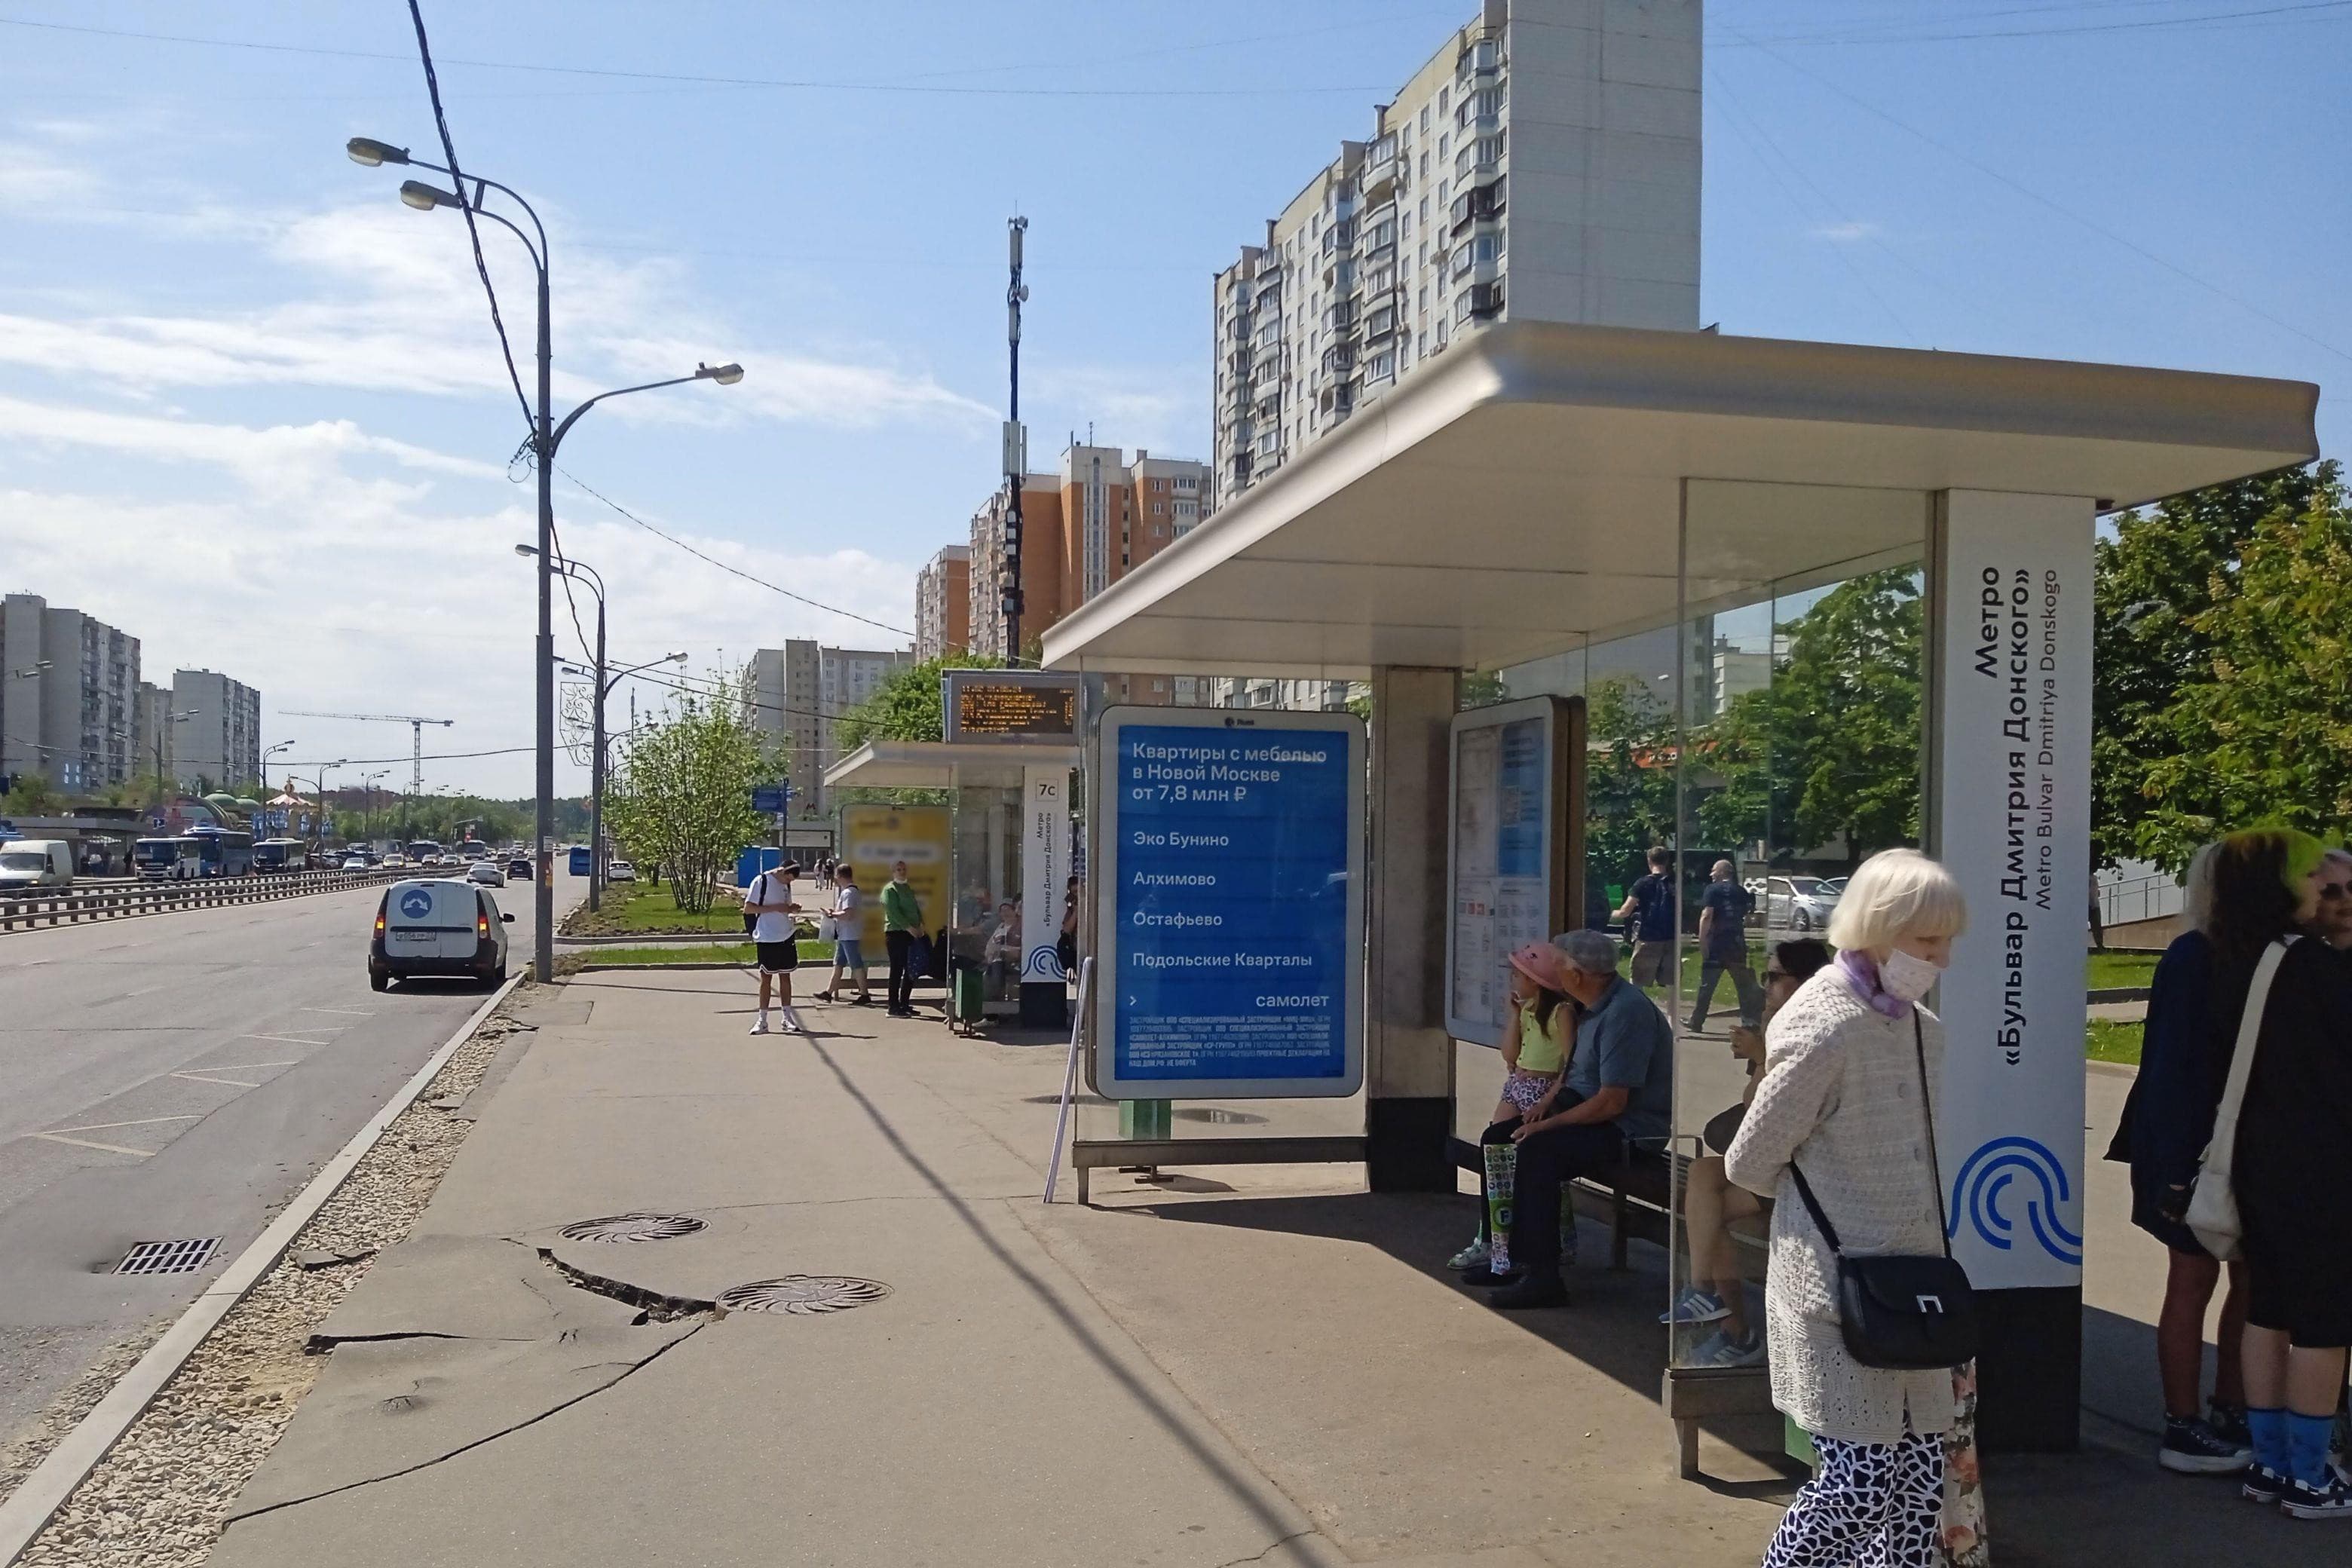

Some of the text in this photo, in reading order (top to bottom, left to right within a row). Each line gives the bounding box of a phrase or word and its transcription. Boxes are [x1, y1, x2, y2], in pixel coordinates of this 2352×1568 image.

[1975, 568, 2004, 678] Метро
[2036, 570, 2060, 910] Metro Bulvar Dmitriya Donskogo
[1134, 743, 1326, 763] Квартиры с мебелью
[1134, 762, 1279, 781] в Новой Москве
[1133, 789, 1153, 799] от
[1158, 785, 1187, 803] 7,8
[1193, 790, 1228, 801] млн
[1998, 569, 2030, 1065] «Бульвар Дмитрия Донского»
[1134, 831, 1228, 848] Эко Бунино
[1134, 871, 1215, 885] Алхимово
[1134, 911, 1222, 929] Остафьево
[1133, 953, 1311, 969] Подольские Кварталы
[1257, 996, 1329, 1006] самолет
